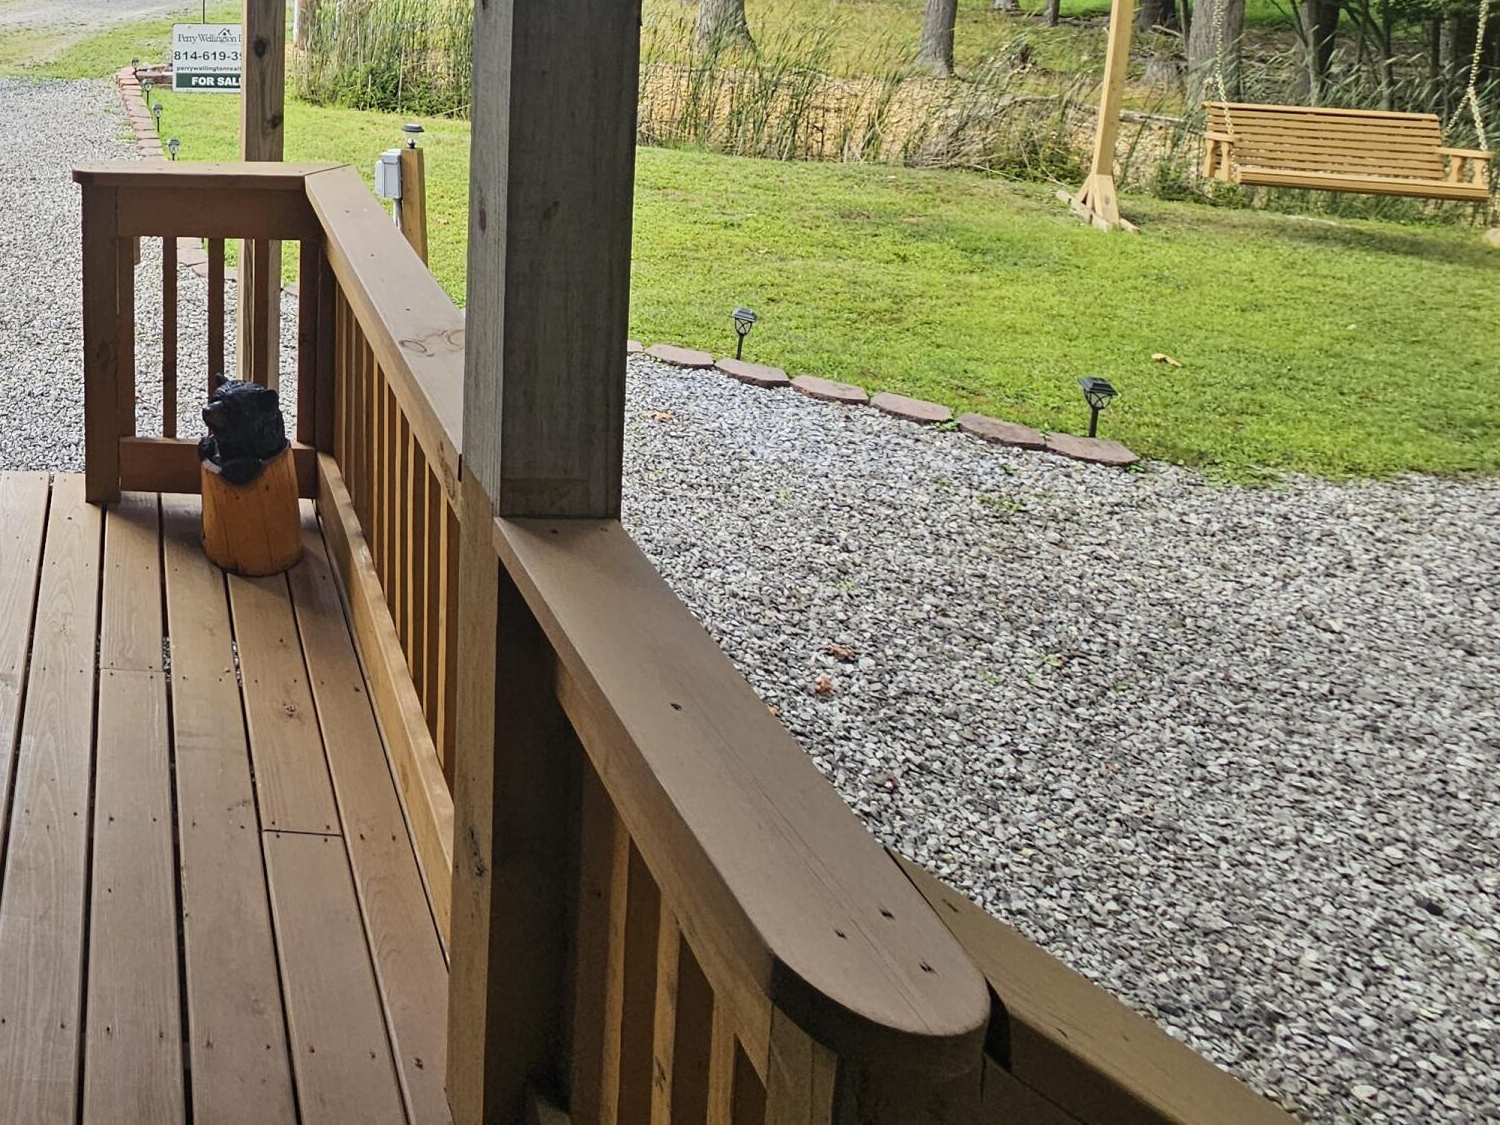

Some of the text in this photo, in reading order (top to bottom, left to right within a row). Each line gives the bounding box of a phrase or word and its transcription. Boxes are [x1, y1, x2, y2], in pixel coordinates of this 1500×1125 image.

[178, 34, 197, 44] Perry
[198, 33, 237, 44] Wellington
[191, 76, 215, 86] FOR
